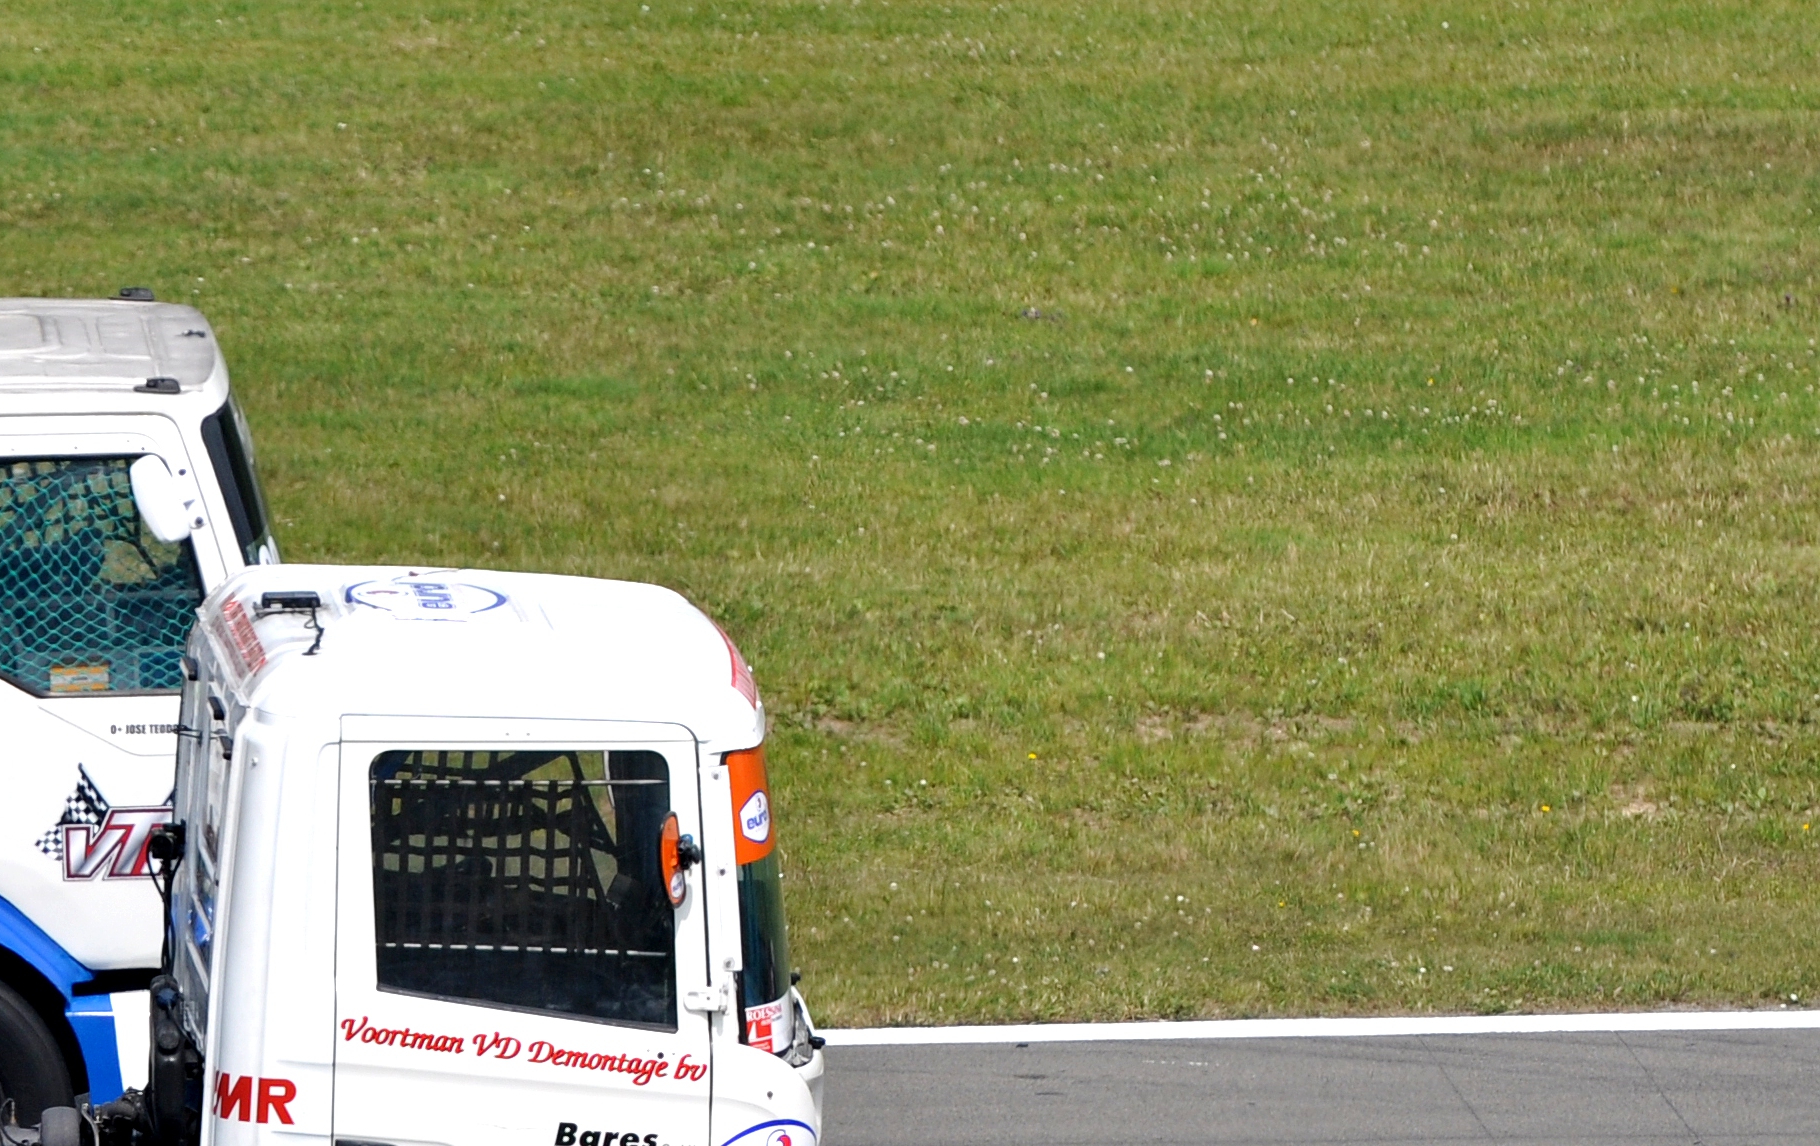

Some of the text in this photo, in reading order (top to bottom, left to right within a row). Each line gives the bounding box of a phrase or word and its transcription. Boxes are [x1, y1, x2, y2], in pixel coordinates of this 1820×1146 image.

[125, 724, 147, 735] JOSE
[341, 1016, 708, 1085] Voortman VD Demontage bv
